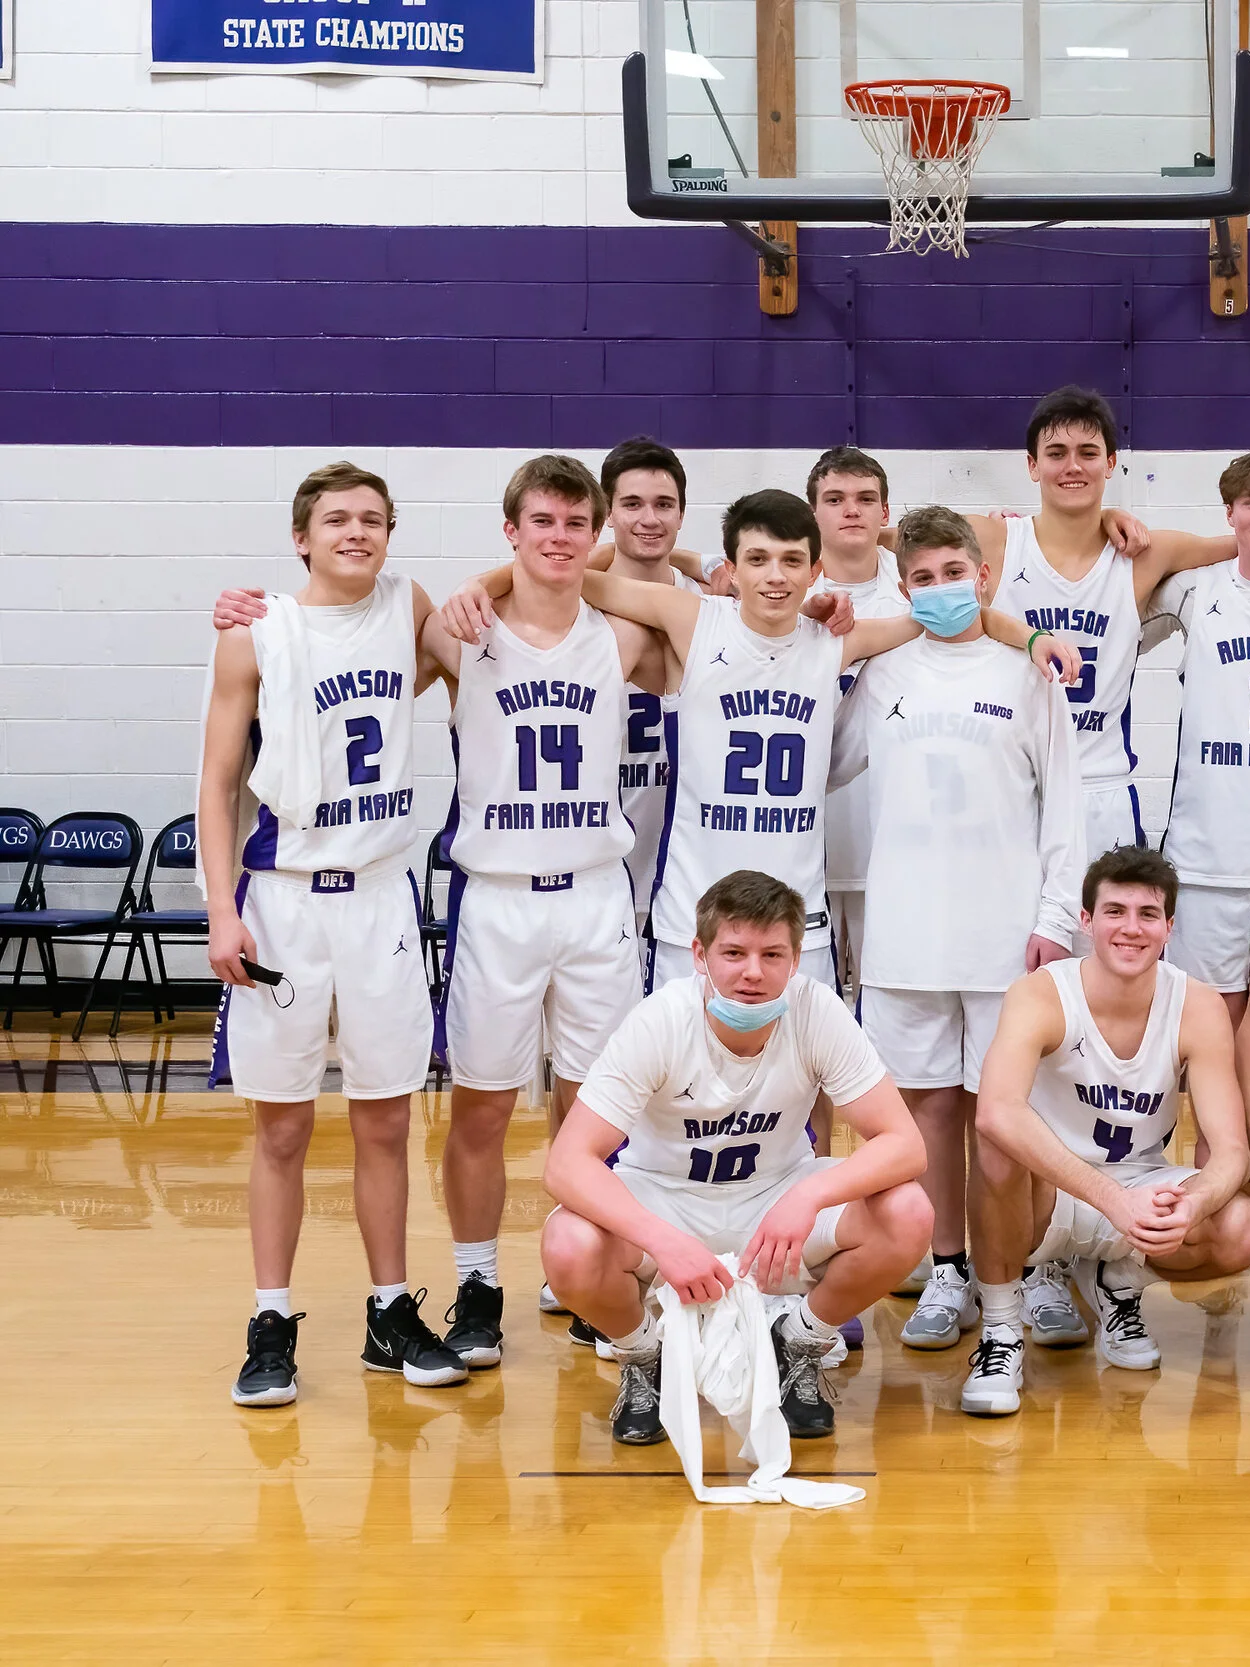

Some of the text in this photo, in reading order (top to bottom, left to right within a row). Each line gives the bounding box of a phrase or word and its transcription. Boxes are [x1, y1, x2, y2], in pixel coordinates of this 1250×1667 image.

[223, 18, 465, 53] STATE CHAMPIONS
[672, 179, 728, 193] SPALDING
[1226, 300, 1233, 313] 5
[1024, 607, 1110, 638] RUMSON
[1050, 646, 1098, 704] 5
[495, 679, 597, 717] RUMSON
[719, 689, 817, 724] RUMSON
[973, 702, 1014, 720] DAWGS
[1071, 709, 1109, 732] VEN
[344, 715, 384, 787] 2
[515, 724, 583, 792] 14
[723, 730, 806, 797] 20
[1200, 741, 1243, 766] FAIR
[618, 763, 649, 788] AIR
[314, 798, 352, 828] AIR
[484, 801, 610, 830] FAIR HAVEN
[700, 802, 817, 833] FAIR HAVEN
[50, 830, 124, 850] DAWGS
[319, 872, 348, 888] DFL
[1074, 1083, 1165, 1116] RUMSON
[683, 1110, 783, 1139] RUMSON
[1092, 1117, 1134, 1163] 4
[688, 1142, 761, 1183] 10
